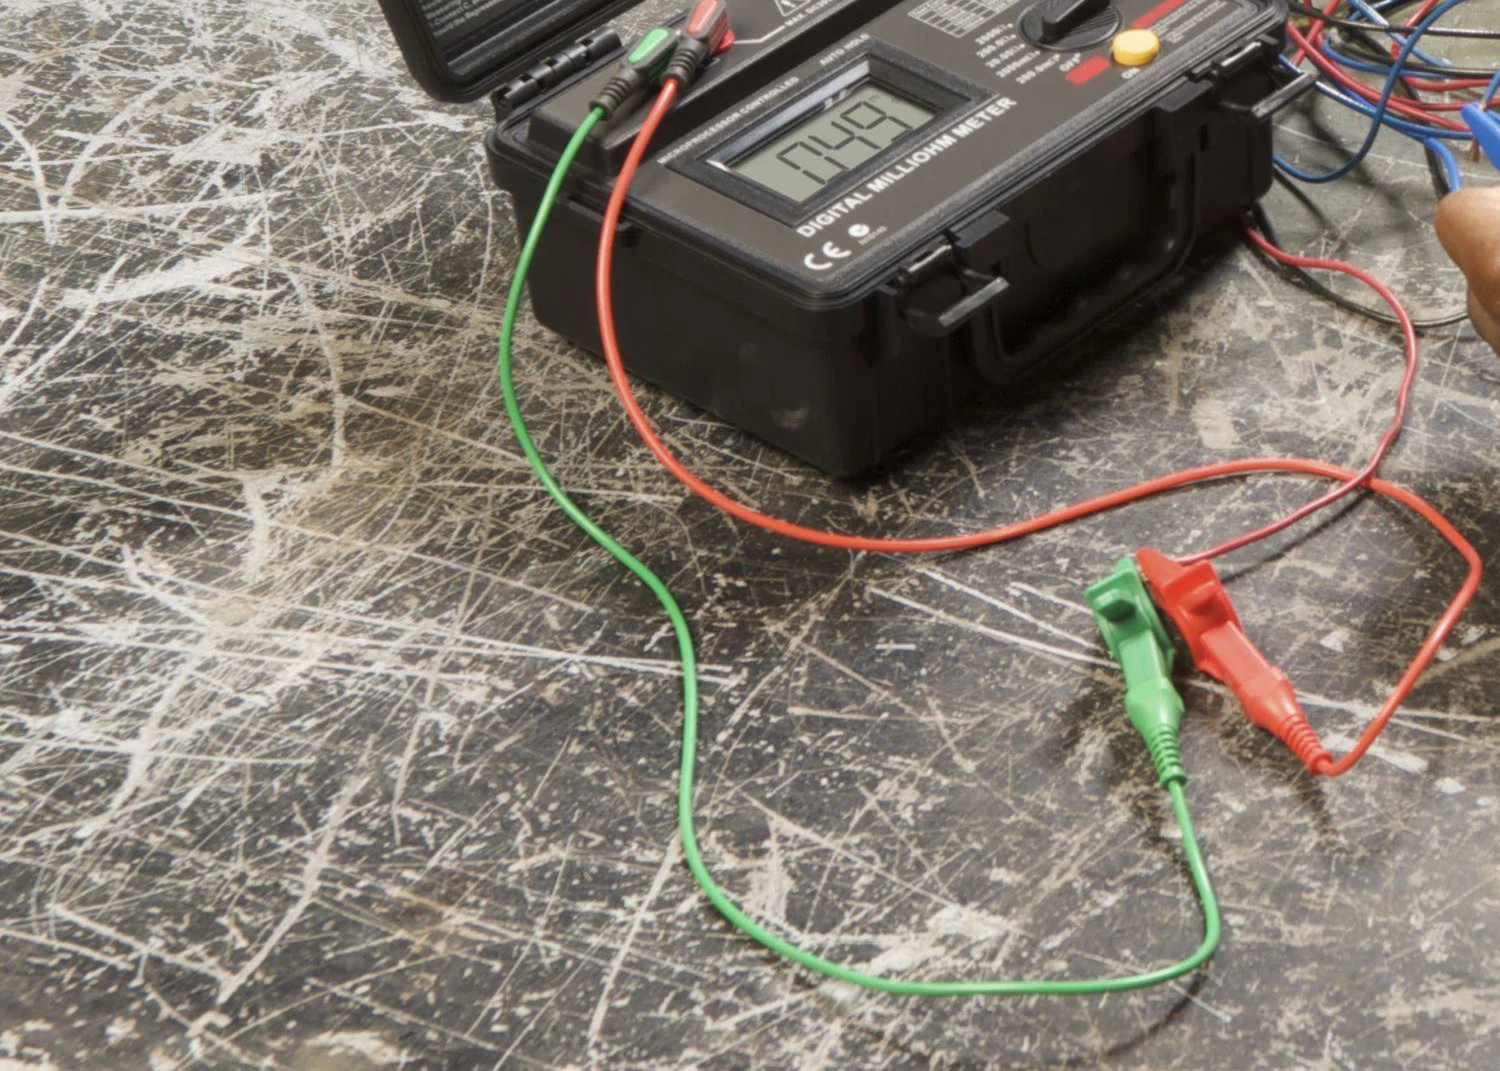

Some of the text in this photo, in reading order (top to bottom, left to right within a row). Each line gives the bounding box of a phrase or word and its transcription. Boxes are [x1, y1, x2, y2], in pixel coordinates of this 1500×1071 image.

[657, 33, 869, 163] MICROPROCESSOR CONTROLLED AUTO HOLD
[1059, 56, 1080, 71] OFF
[796, 97, 1017, 237] DIGITAL MILLIOHM METER
